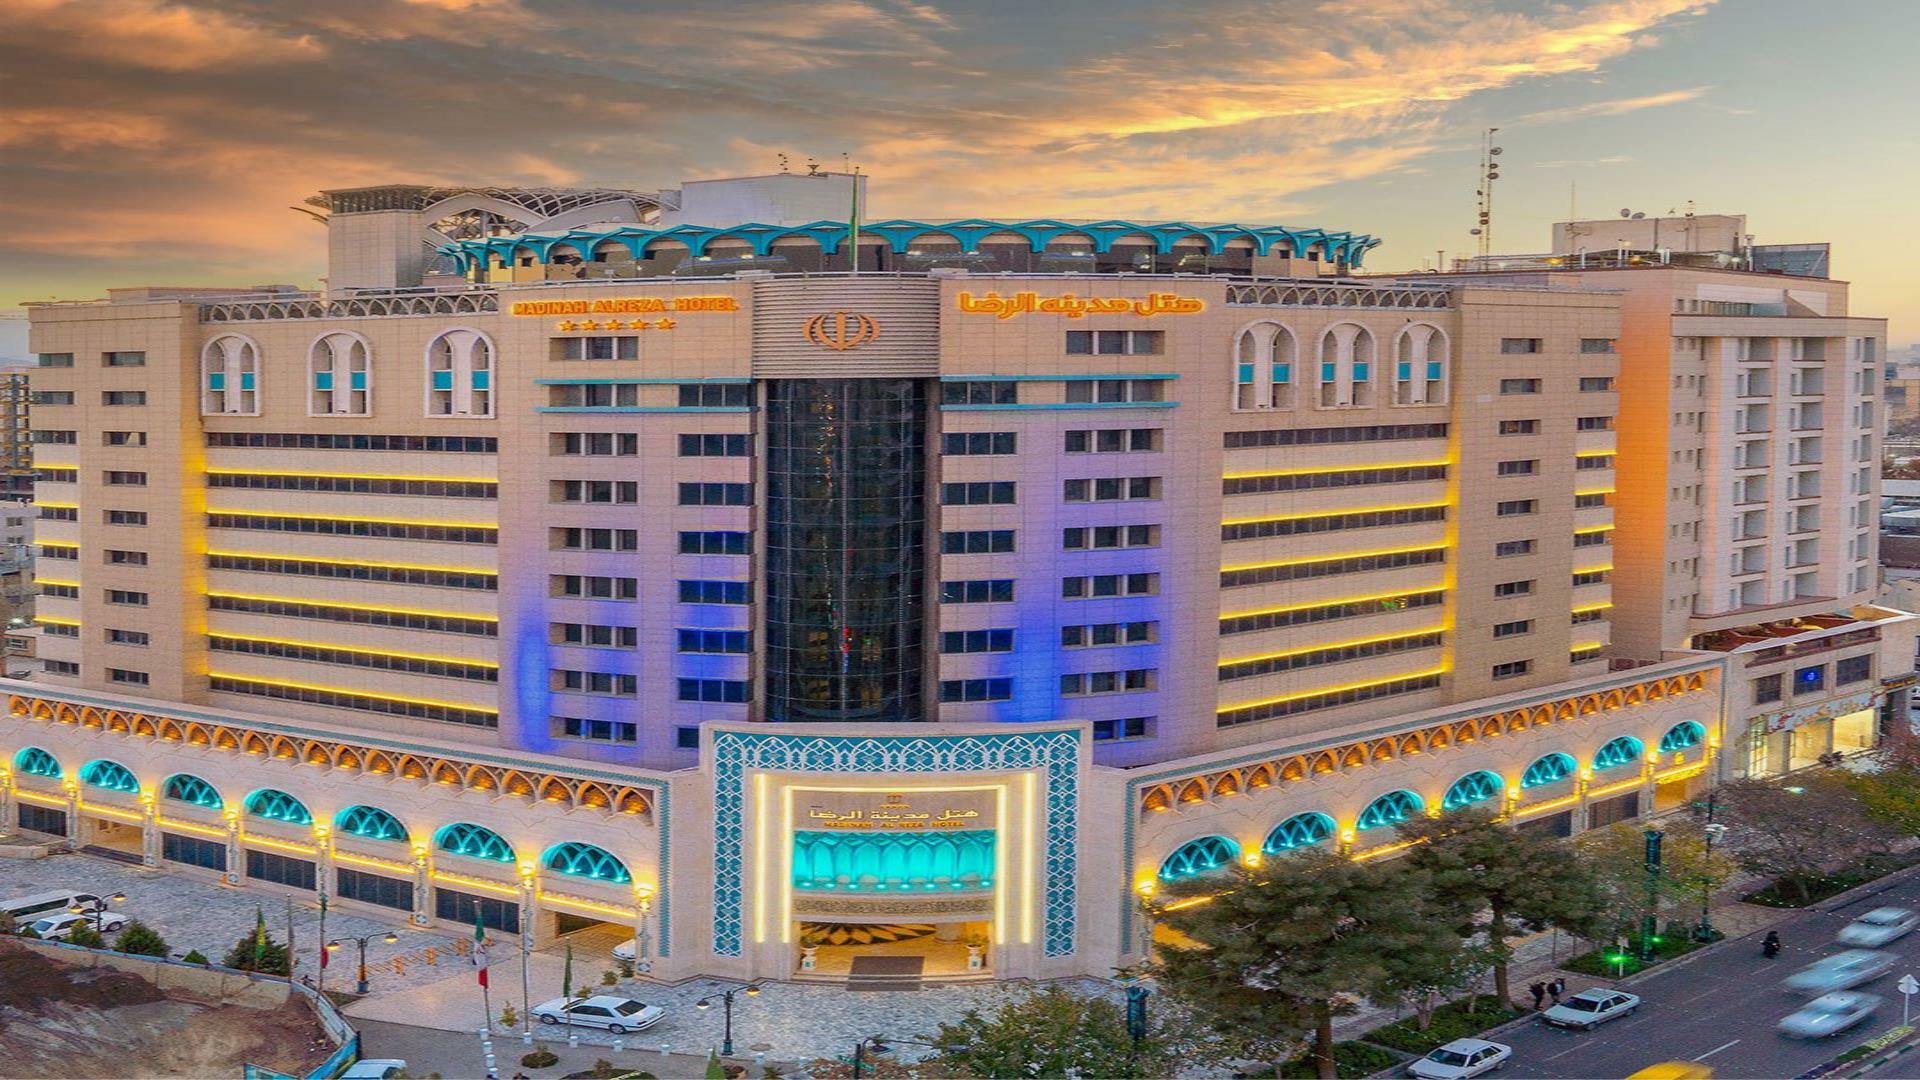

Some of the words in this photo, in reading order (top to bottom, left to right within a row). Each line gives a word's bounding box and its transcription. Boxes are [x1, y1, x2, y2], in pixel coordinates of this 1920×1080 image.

[513, 301, 588, 315] MADINAH
[674, 296, 738, 312] HOTEL
[959, 292, 1036, 319] الرضا
[1135, 293, 1203, 316] هتل
[809, 809, 863, 821] الرضا
[936, 808, 979, 820] هتل
